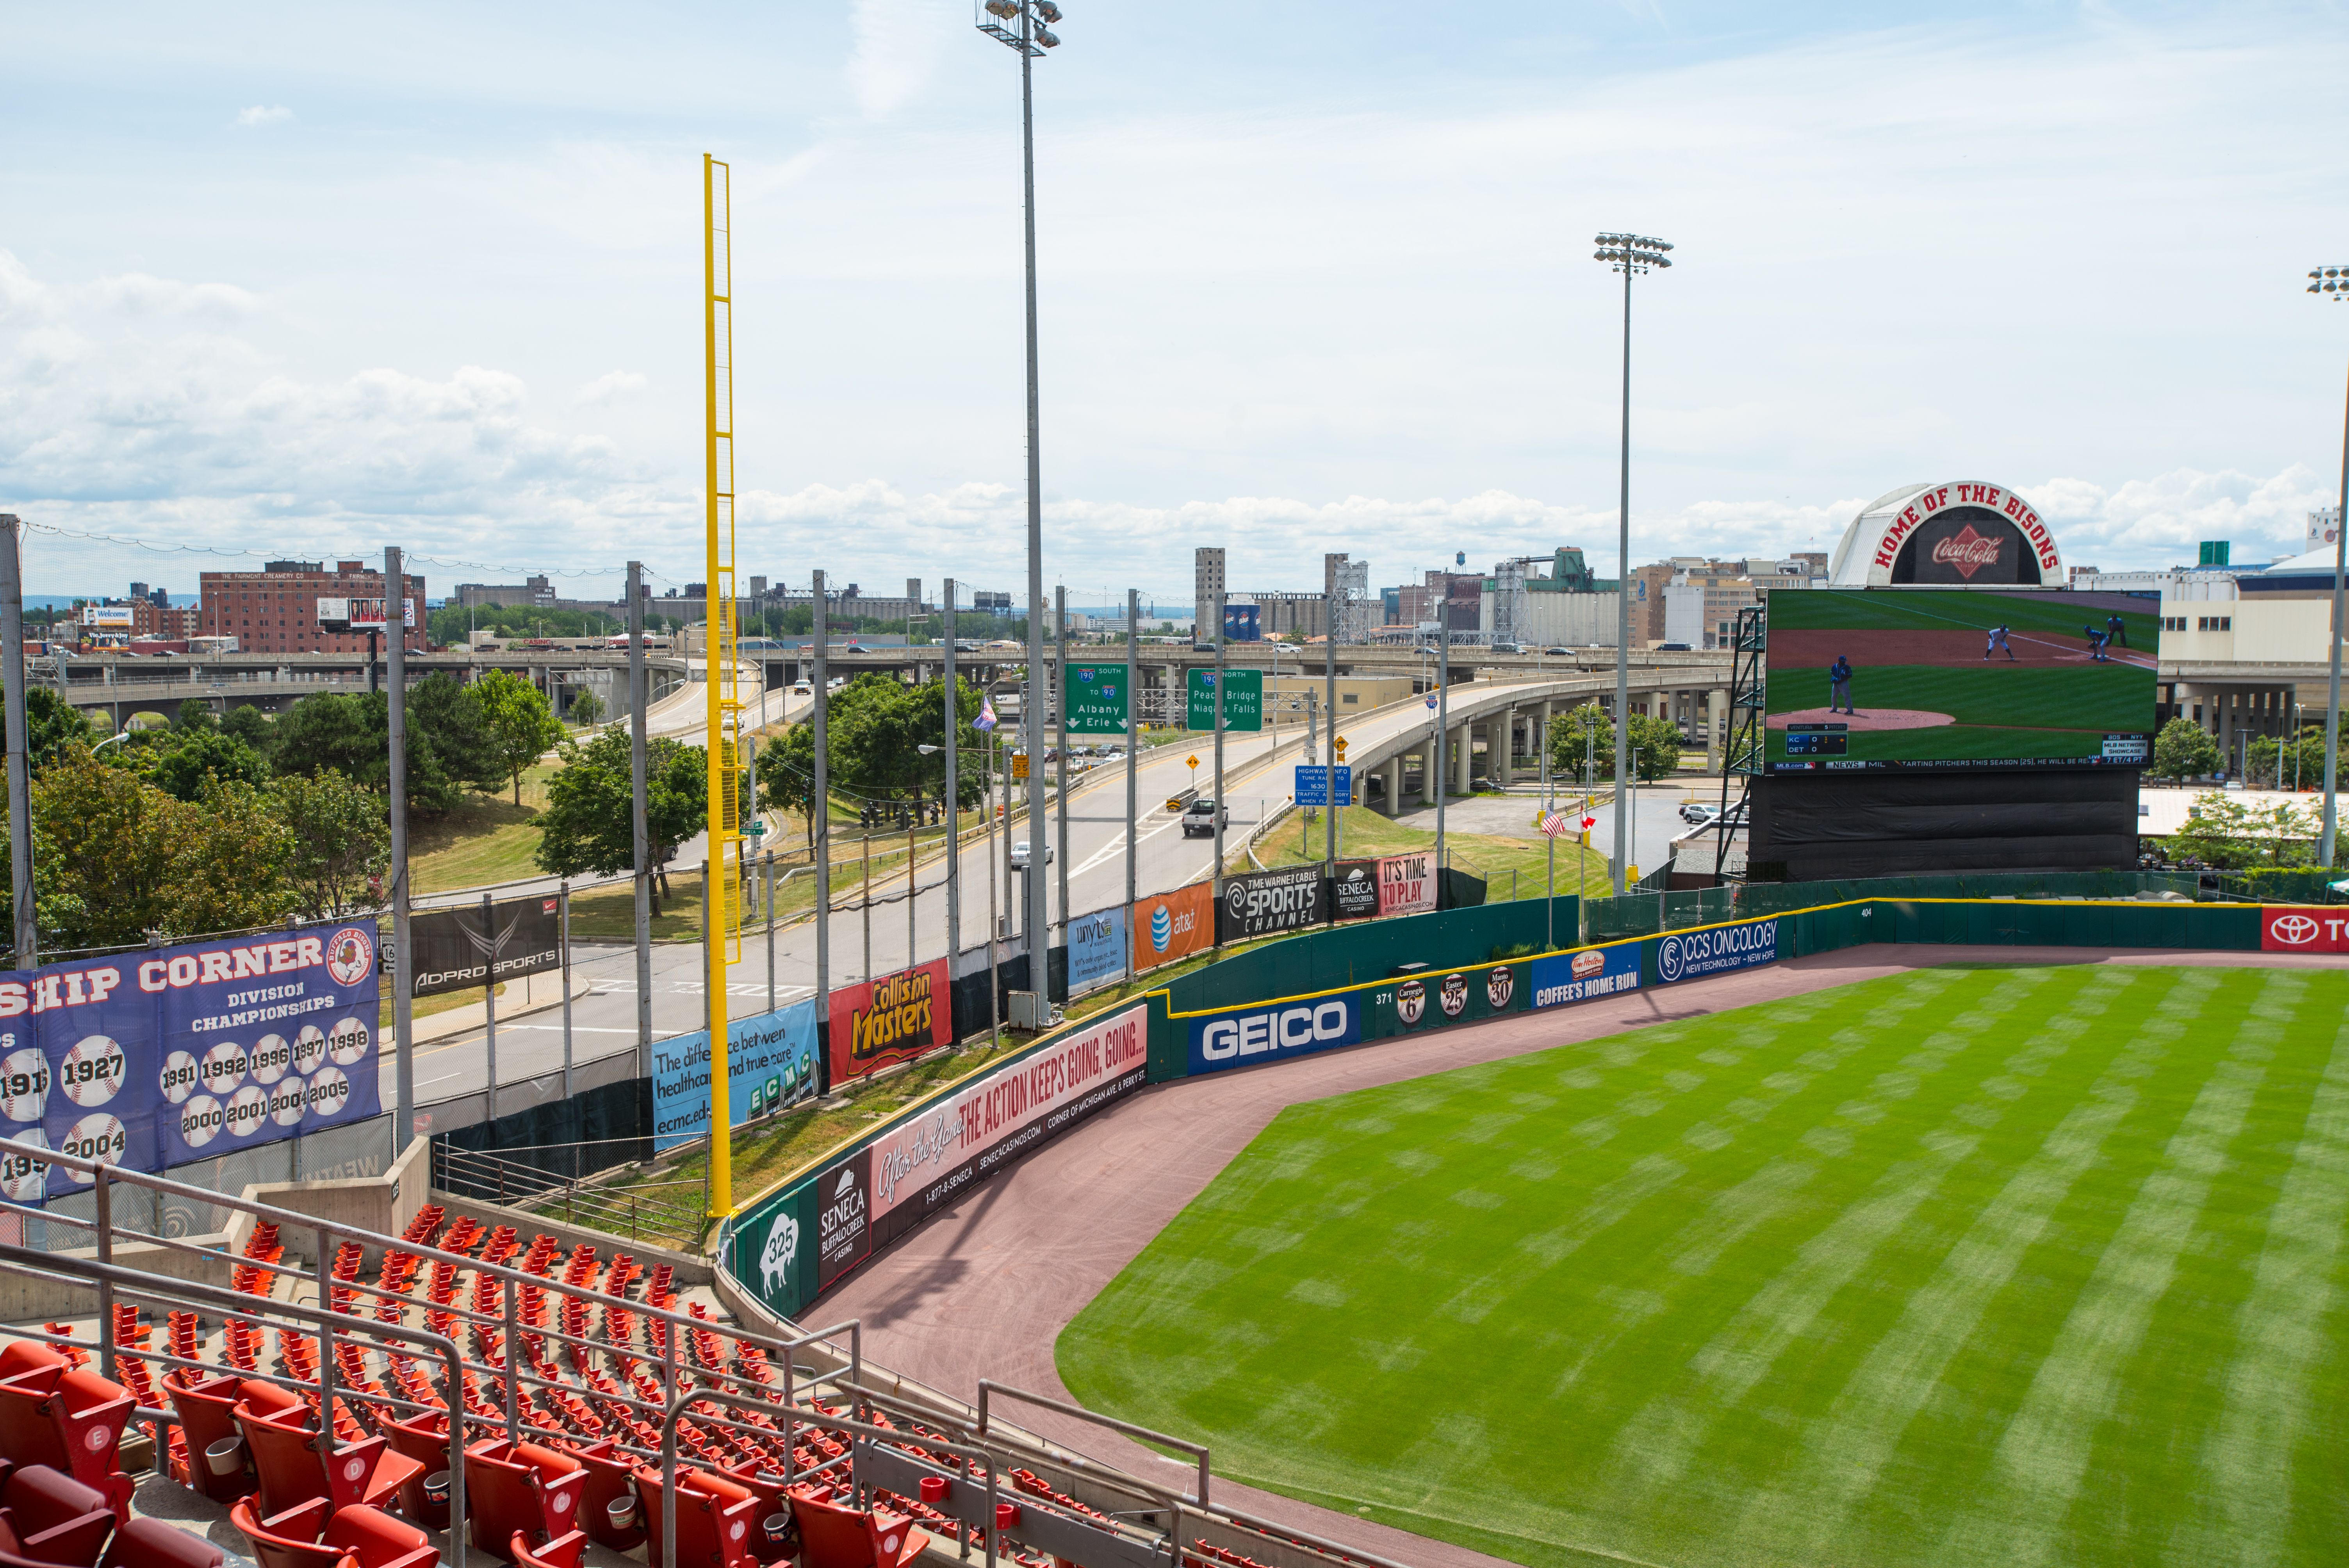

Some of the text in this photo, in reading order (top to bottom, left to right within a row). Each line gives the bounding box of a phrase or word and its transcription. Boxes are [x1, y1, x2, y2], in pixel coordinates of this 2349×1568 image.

[1875, 485, 2058, 570] HOME OF THE BISONS
[1227, 691, 1255, 702] Bridge
[1078, 704, 1119, 715] Albany
[1234, 704, 1255, 713] Falls
[1087, 718, 1110, 726] Erie
[1248, 871, 1317, 889] TIME WARNER CABLE
[1383, 858, 1427, 883] IT'S TIME
[1247, 882, 1317, 917] SPORTS
[1337, 881, 1373, 895] SENECA
[1383, 881, 1422, 905] TO PLAY
[1385, 902, 1433, 912] SENECACASINOS.COM
[1862, 908, 1871, 917] 404
[1174, 909, 1195, 935] at&t
[1245, 909, 1314, 932] CHANNEL
[1076, 919, 1105, 948] unyts
[1686, 921, 1777, 960] CCS ONCOLOGY
[329, 931, 371, 961] BUFFALO BISONS
[139, 938, 323, 993] CORNER
[416, 950, 555, 995] ADPRO SPORTS
[1573, 957, 1604, 969] Tim Hortons
[1686, 950, 1774, 974] NEW TECHNOLOGY NEW HOPE
[228, 982, 304, 1007] DIVISION
[873, 971, 930, 1012] Collision
[1399, 987, 1424, 997] Carnegie
[1446, 981, 1462, 989] Easter
[1492, 980, 1509, 1003] 30
[1537, 971, 1637, 1007] COFFEE'S HOME RUN
[1376, 993, 1392, 1005] 371
[1406, 996, 1416, 1017] 6
[1445, 987, 1463, 1011] 25
[192, 995, 335, 1032] CHAMPIONSHIPS
[852, 997, 932, 1054] Masters
[1203, 1001, 1347, 1060] GEICO
[294, 1039, 324, 1061] 1997
[330, 1031, 368, 1052] 1998
[64, 1054, 123, 1085] 1927
[203, 1057, 246, 1079] 1992
[252, 1048, 289, 1070] 1996
[655, 1054, 681, 1074] The
[746, 1055, 768, 1073] true
[163, 1066, 195, 1088] 1991
[959, 1021, 1144, 1149] THE ACTION KEEPS GOING, GOING...
[271, 1090, 307, 1112] 2004
[310, 1081, 349, 1103] 2005
[183, 1110, 222, 1133] 2000
[226, 1100, 267, 1123] 2001
[64, 1131, 125, 1159] 2004
[926, 1166, 972, 1205] 1-877-8-SENECA
[980, 1124, 1041, 1170] SENECACASINOS.COM
[1048, 1108, 1069, 1129] CORNER
[1071, 1104, 1078, 1116] OF
[1079, 1090, 1105, 1112] MICHIGAN
[1106, 1085, 1117, 1098] AVE.
[1118, 1082, 1122, 1091] &
[1123, 1074, 1138, 1089] PERRY
[879, 1114, 965, 1203] After the Game,
[822, 1188, 864, 1237] SENECA
[822, 1213, 864, 1255] BUFFALO CREEK
[769, 1231, 793, 1263] 325
[835, 1243, 852, 1262] CASINO
[93, 1430, 103, 1446] E
[350, 1463, 359, 1475] D
[558, 1495, 567, 1509] C
[733, 1523, 742, 1536] B
[886, 1537, 897, 1550] A
